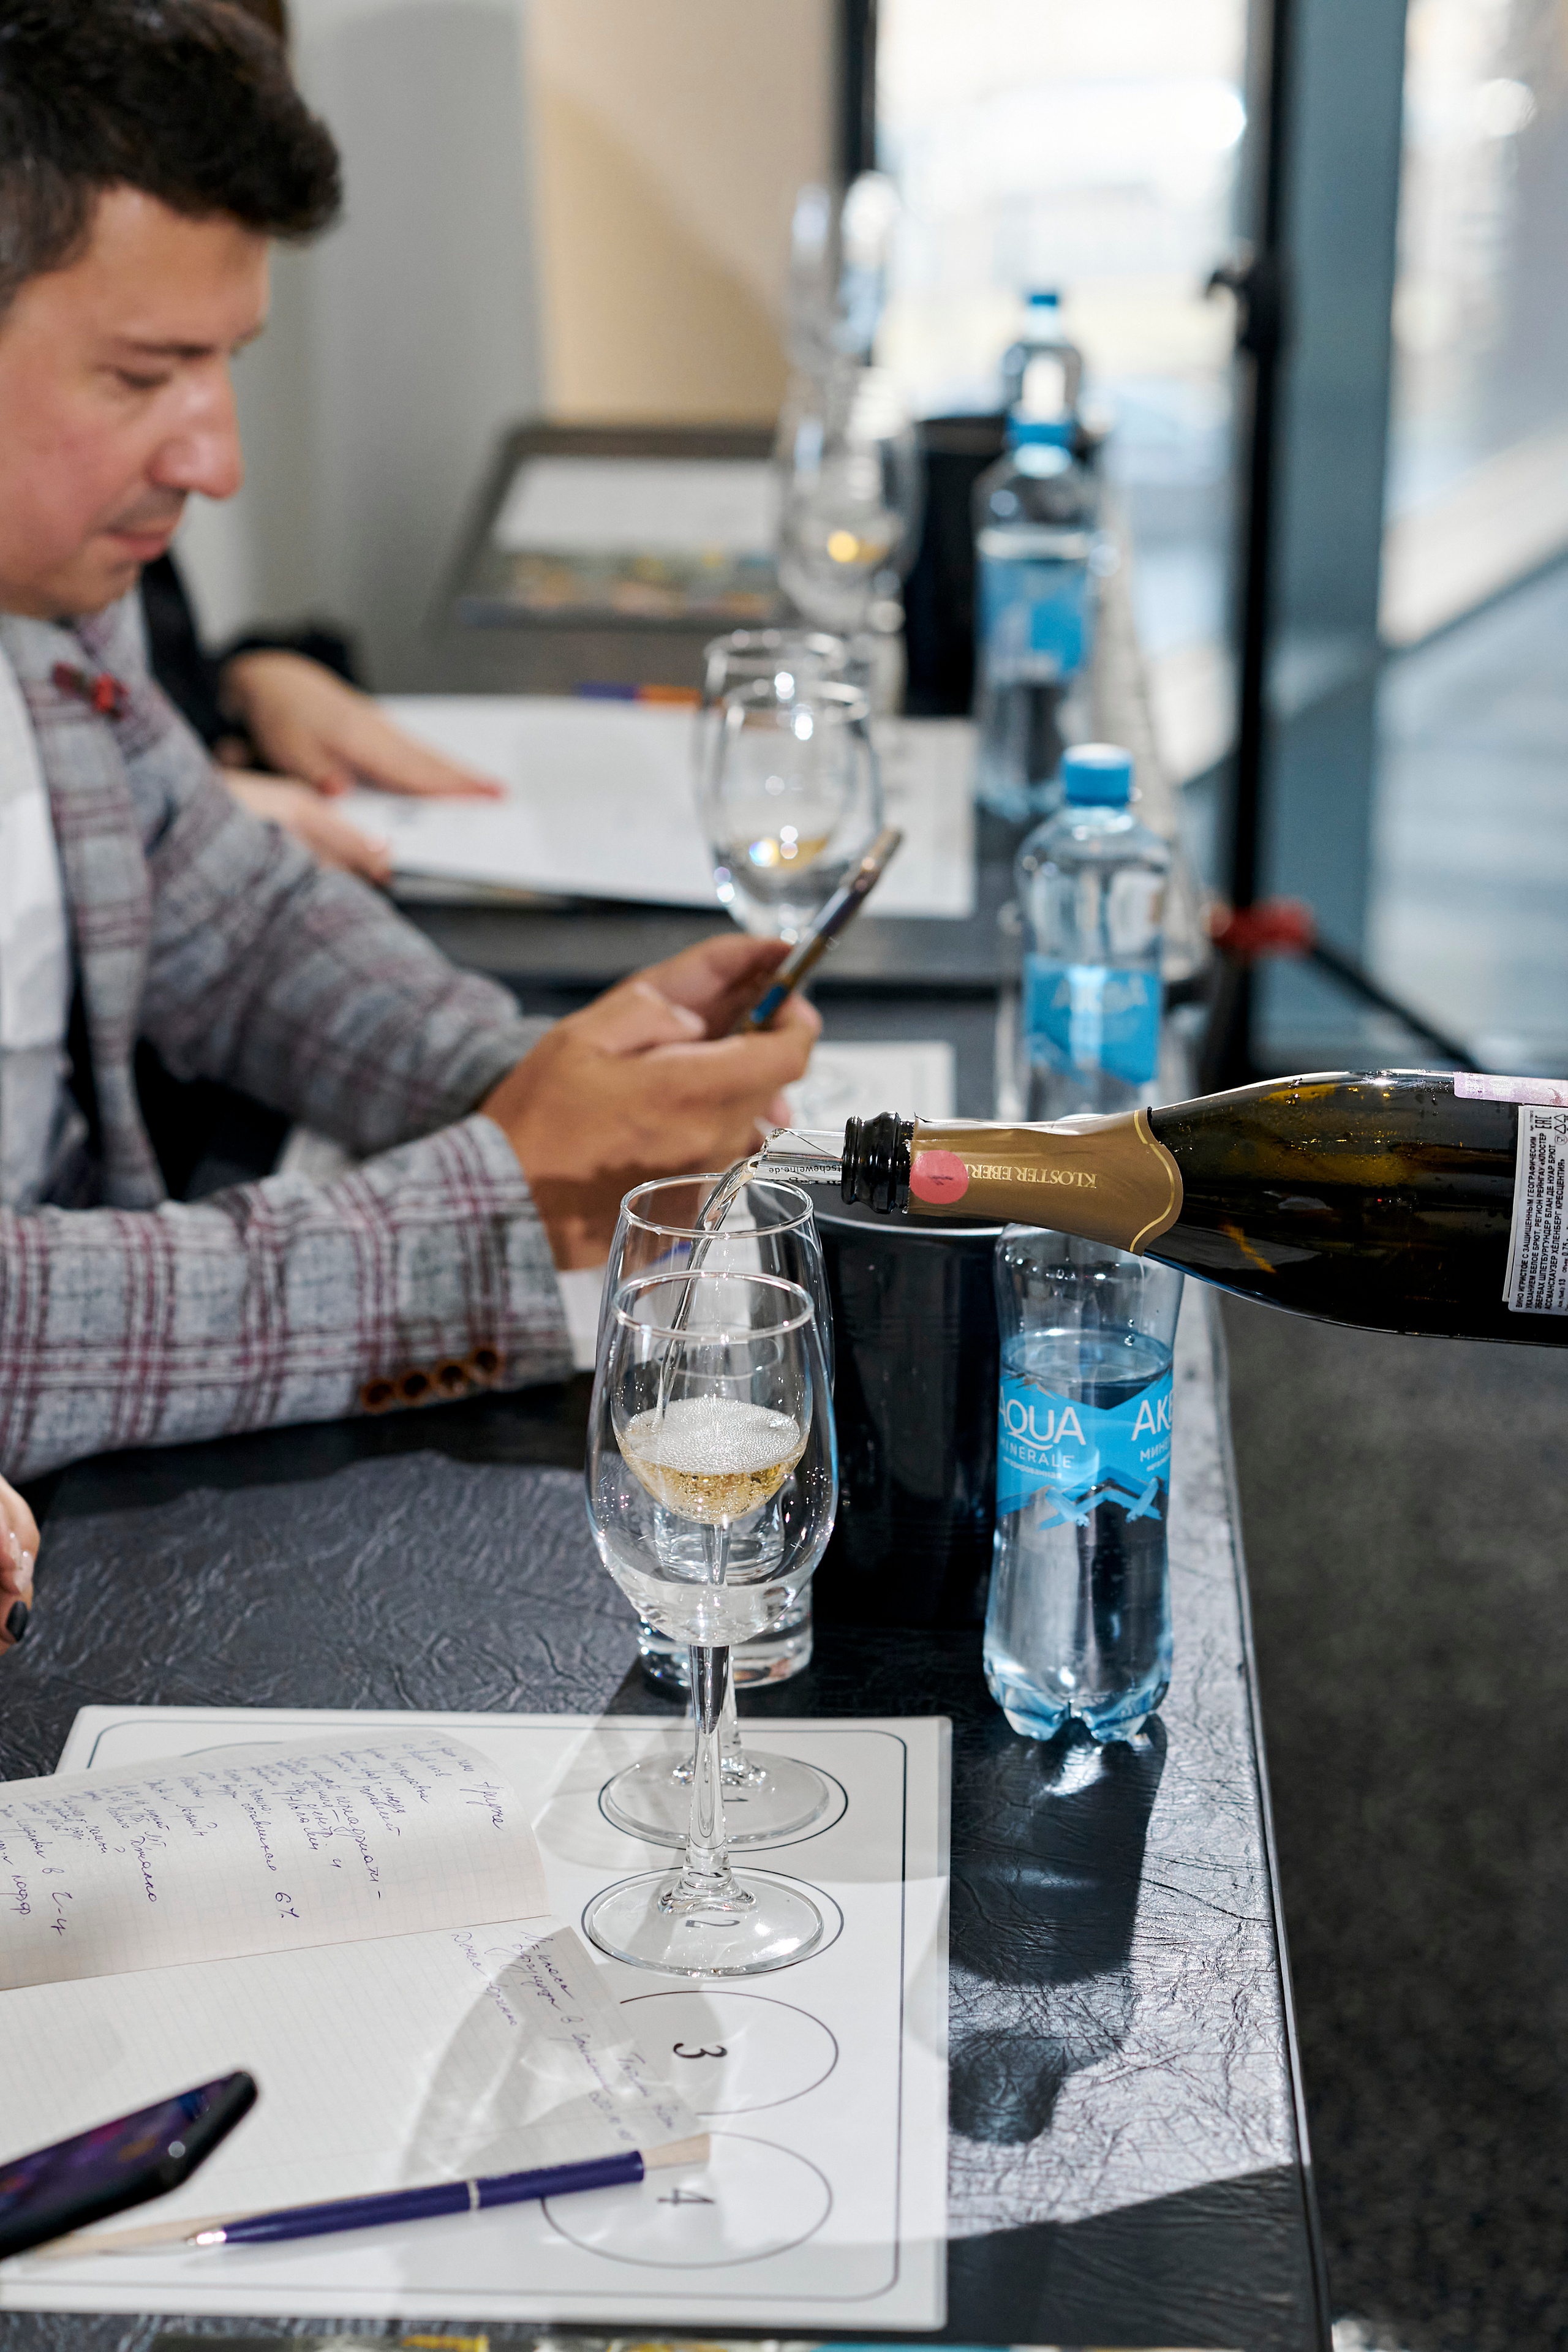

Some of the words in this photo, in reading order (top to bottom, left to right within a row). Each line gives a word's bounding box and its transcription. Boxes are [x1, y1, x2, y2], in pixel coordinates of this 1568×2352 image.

[965, 1164, 1012, 1182] EBER
[1014, 1166, 1097, 1189] KLOSTER
[1547, 1186, 1555, 1196] ДЕ
[1518, 1260, 1528, 1292] ИГРИСТОЕ
[1523, 1199, 1533, 1252] ЗАЩИЩЕННЫМ
[1528, 1137, 1537, 1197] ГЕОГРАФИЧЕСКИМ
[1534, 1200, 1543, 1227] РЕГИОН
[1532, 1229, 1542, 1250] БРЮТ,
[1545, 1256, 1557, 1310] АССМАНСХАУЗЕР
[1555, 1159, 1565, 1209] КРЕСЦЕНТИЯ»
[1539, 1220, 1551, 1280] ШПЕТБУРГУНДЕР
[1530, 1253, 1539, 1274] БЕЛОЕ
[1526, 1276, 1536, 1308] УКАЗАНИЕМ
[1535, 1282, 1545, 1309] ЭБЕРБАХ
[685, 1918, 741, 1929] 2
[673, 2042, 728, 2059] 3
[657, 2187, 715, 2207] 4
